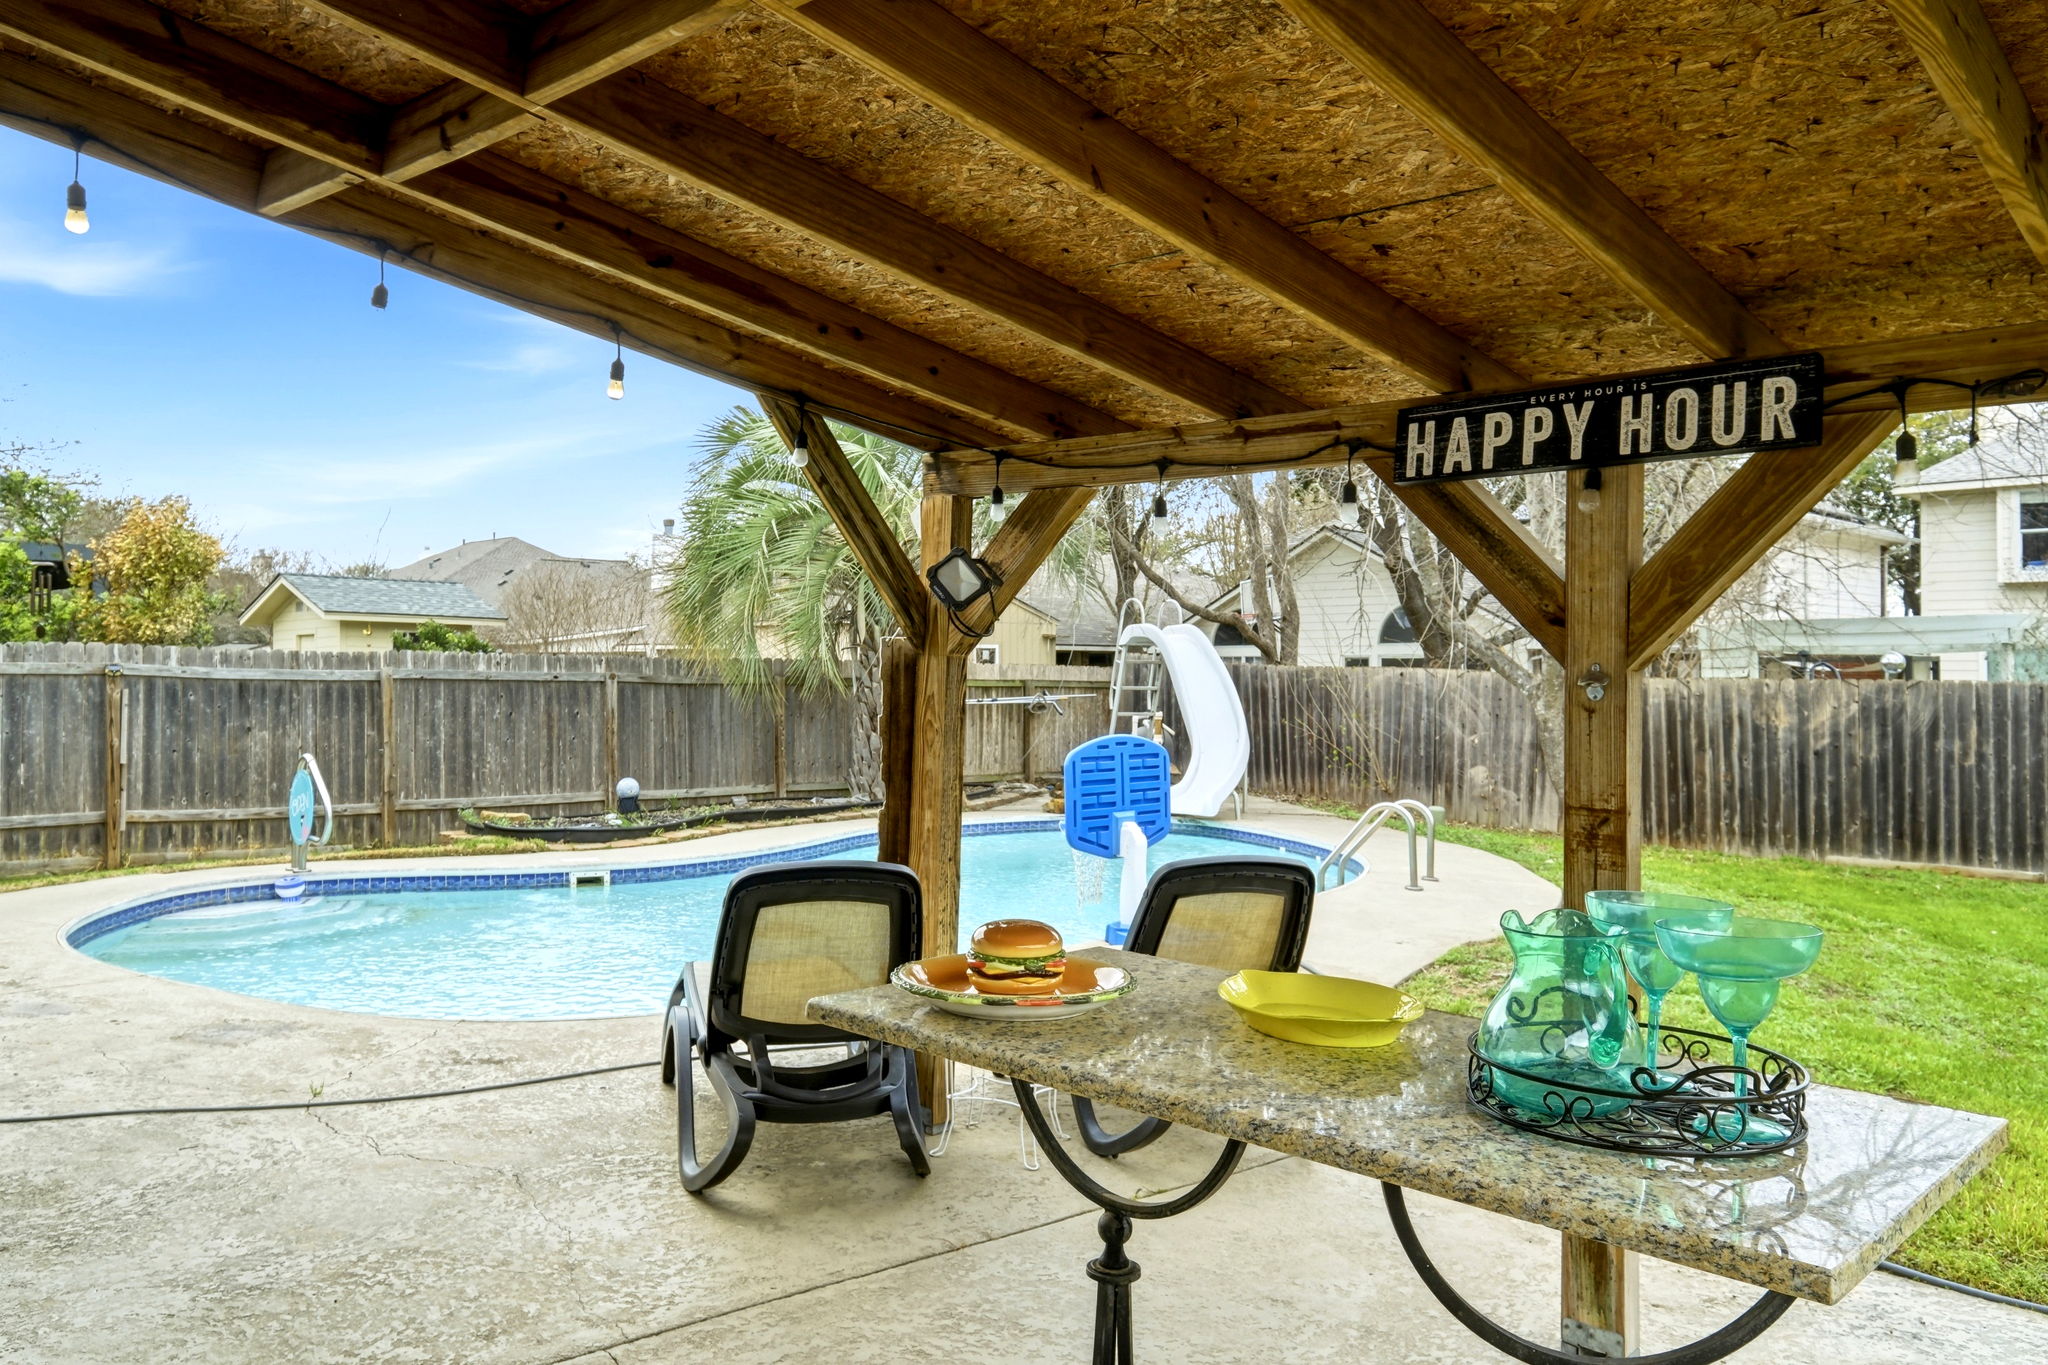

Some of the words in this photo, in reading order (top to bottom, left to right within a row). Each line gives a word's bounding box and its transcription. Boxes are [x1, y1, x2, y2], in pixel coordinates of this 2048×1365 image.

[1530, 391, 1575, 404] EVERY
[1584, 385, 1624, 398] HOUR
[1633, 381, 1648, 391] IS
[1405, 400, 1595, 479] HAPPY
[1619, 375, 1798, 456] HOUR
